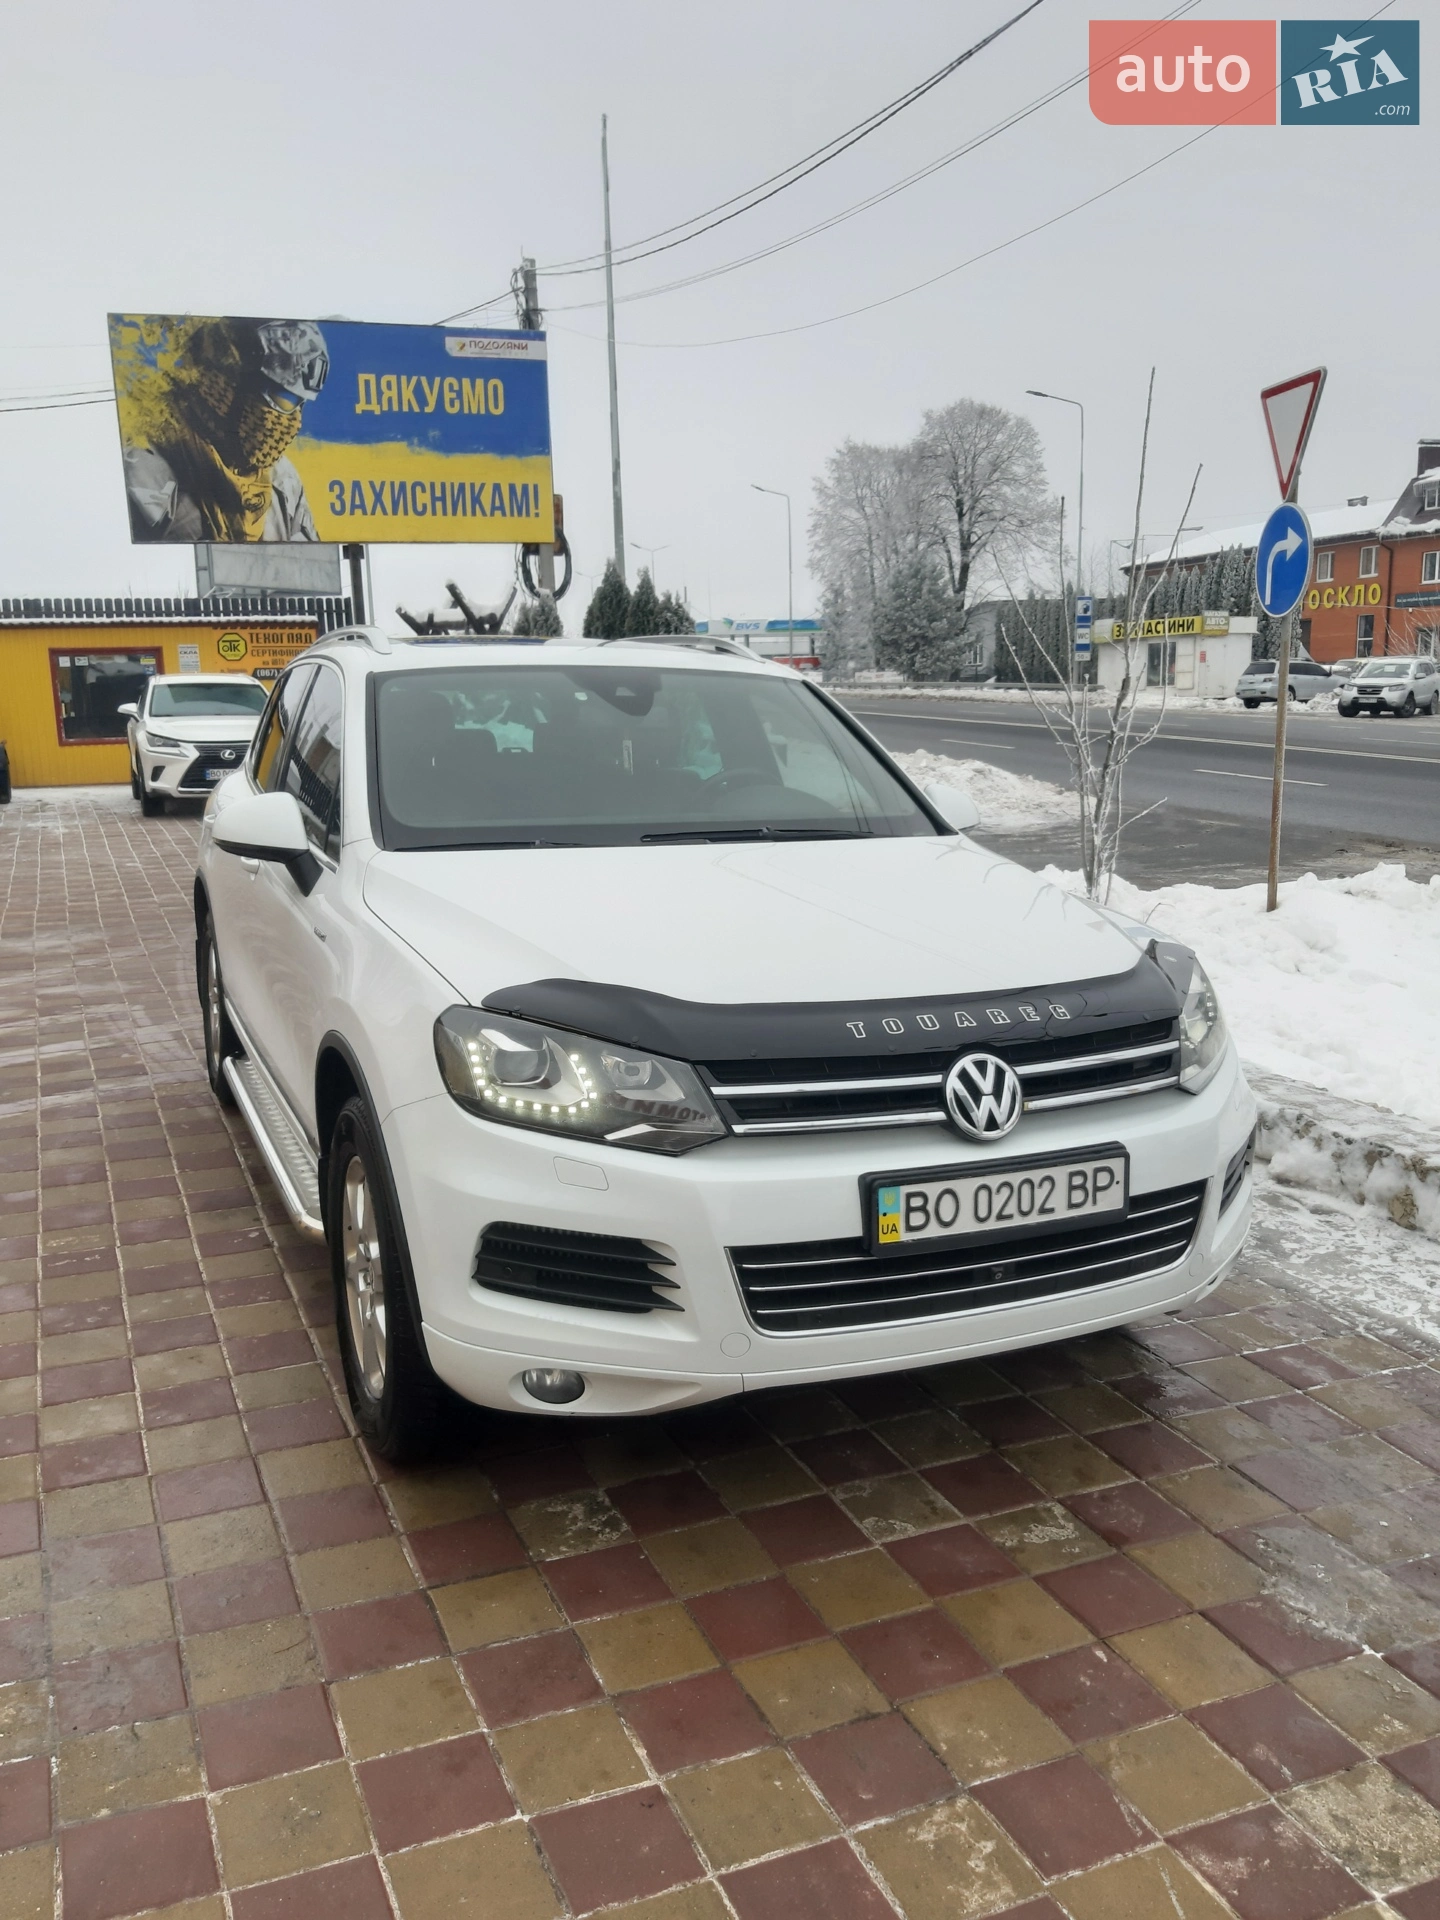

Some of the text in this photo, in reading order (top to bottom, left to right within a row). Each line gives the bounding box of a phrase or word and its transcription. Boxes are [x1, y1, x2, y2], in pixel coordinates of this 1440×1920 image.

[355, 373, 505, 416] ДЯКУЄМО
[328, 479, 540, 518] ЗАХИСНИКАМ!
[1299, 582, 1382, 611] ОСКЛО
[735, 622, 761, 631] BVS
[1077, 632, 1090, 640] WC
[1115, 618, 1195, 638] ЗАСТИНИ
[248, 632, 313, 644] ТЕХОГЛЯД
[251, 648, 306, 658] СЕРТИФІКА
[847, 1003, 1071, 1039] TOUAREG
[905, 1164, 1115, 1233] BO 0202 BP
[881, 1223, 899, 1235] UA
